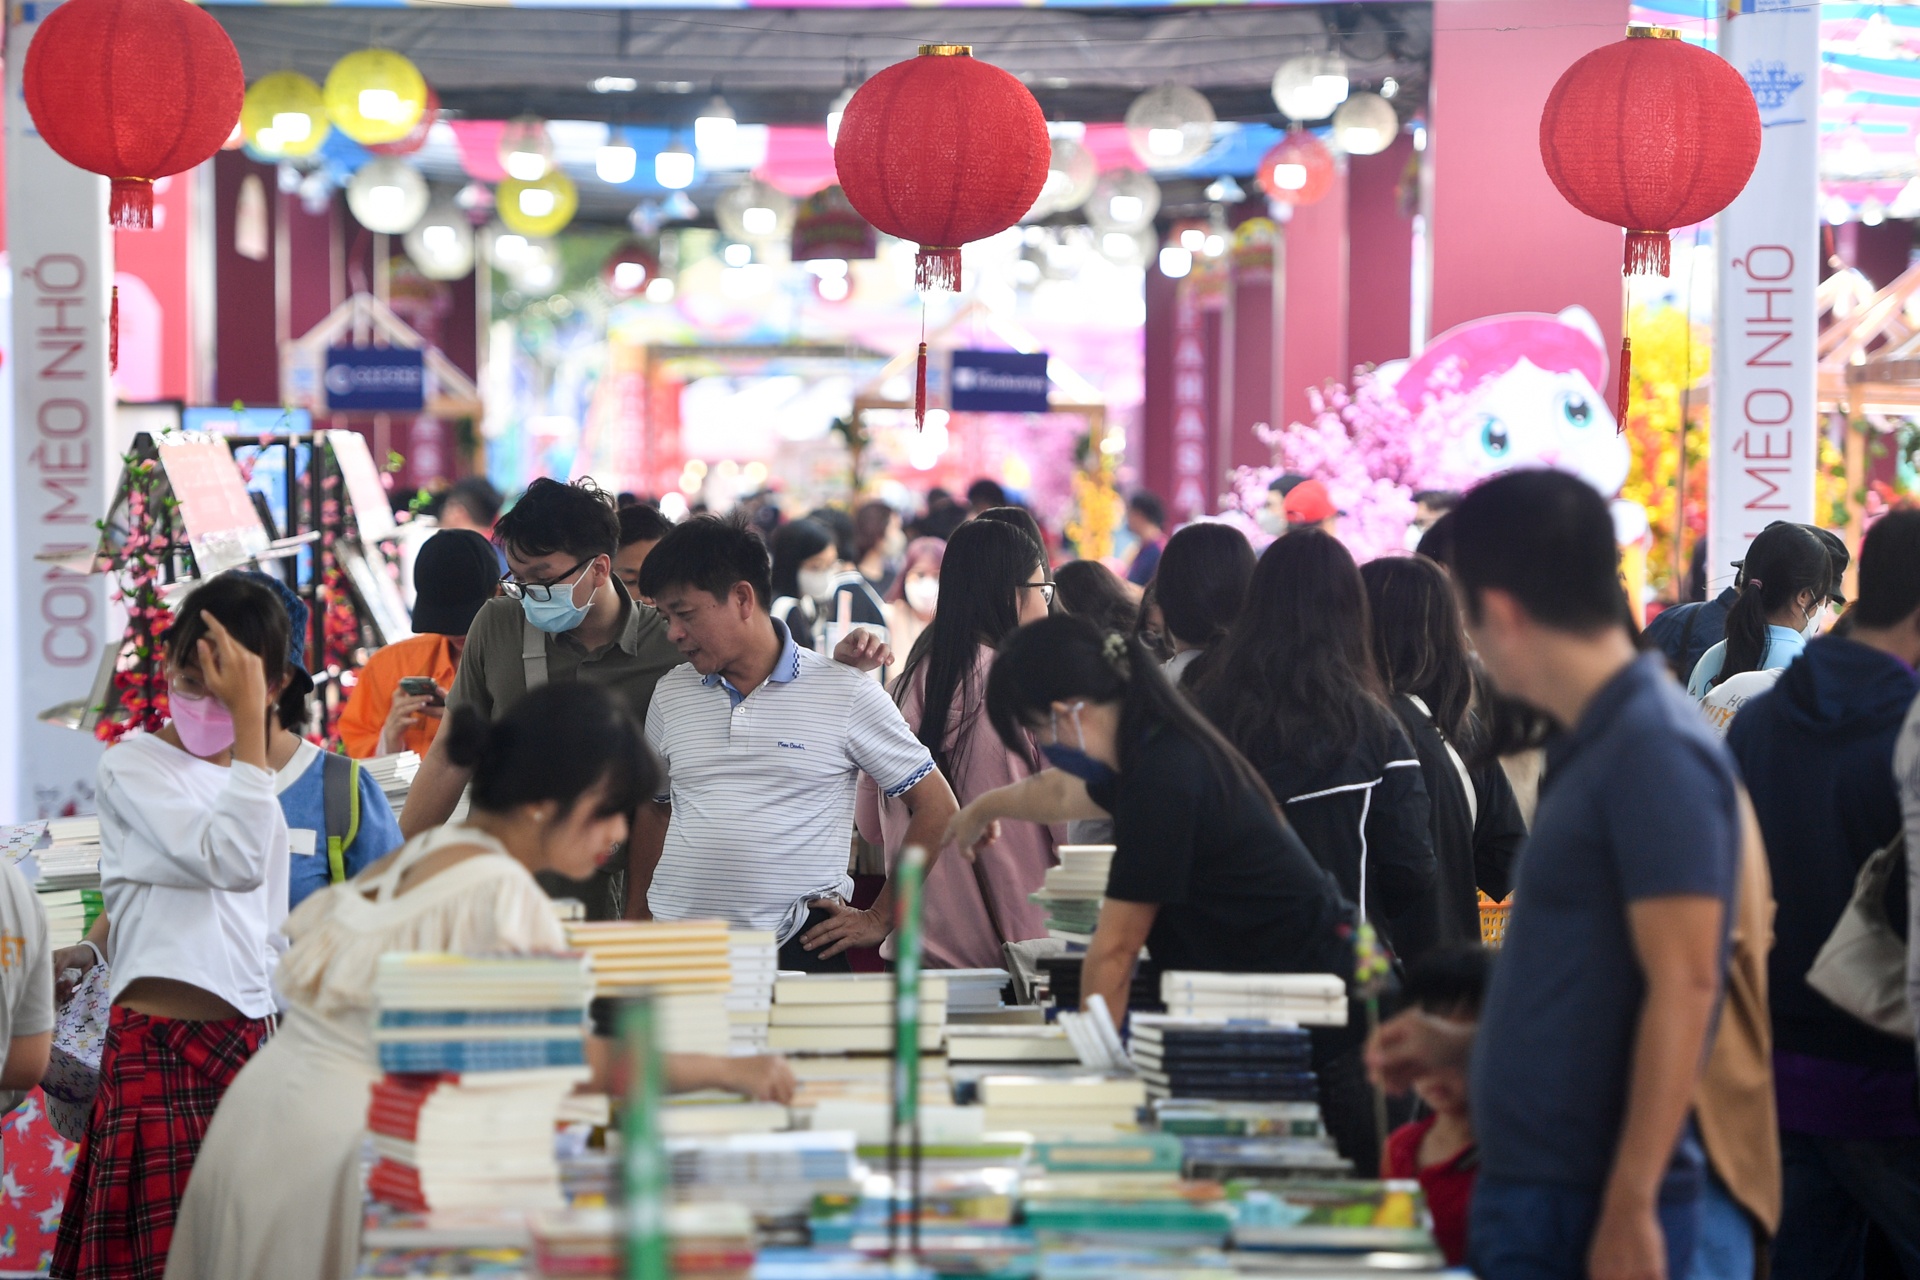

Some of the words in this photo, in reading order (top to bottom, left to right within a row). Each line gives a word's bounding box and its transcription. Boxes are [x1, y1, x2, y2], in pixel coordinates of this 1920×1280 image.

[21, 253, 86, 380] NHỎ
[1731, 244, 1794, 367] NHỎ
[27, 398, 90, 525] MÈO
[1732, 388, 1793, 511] MÈO
